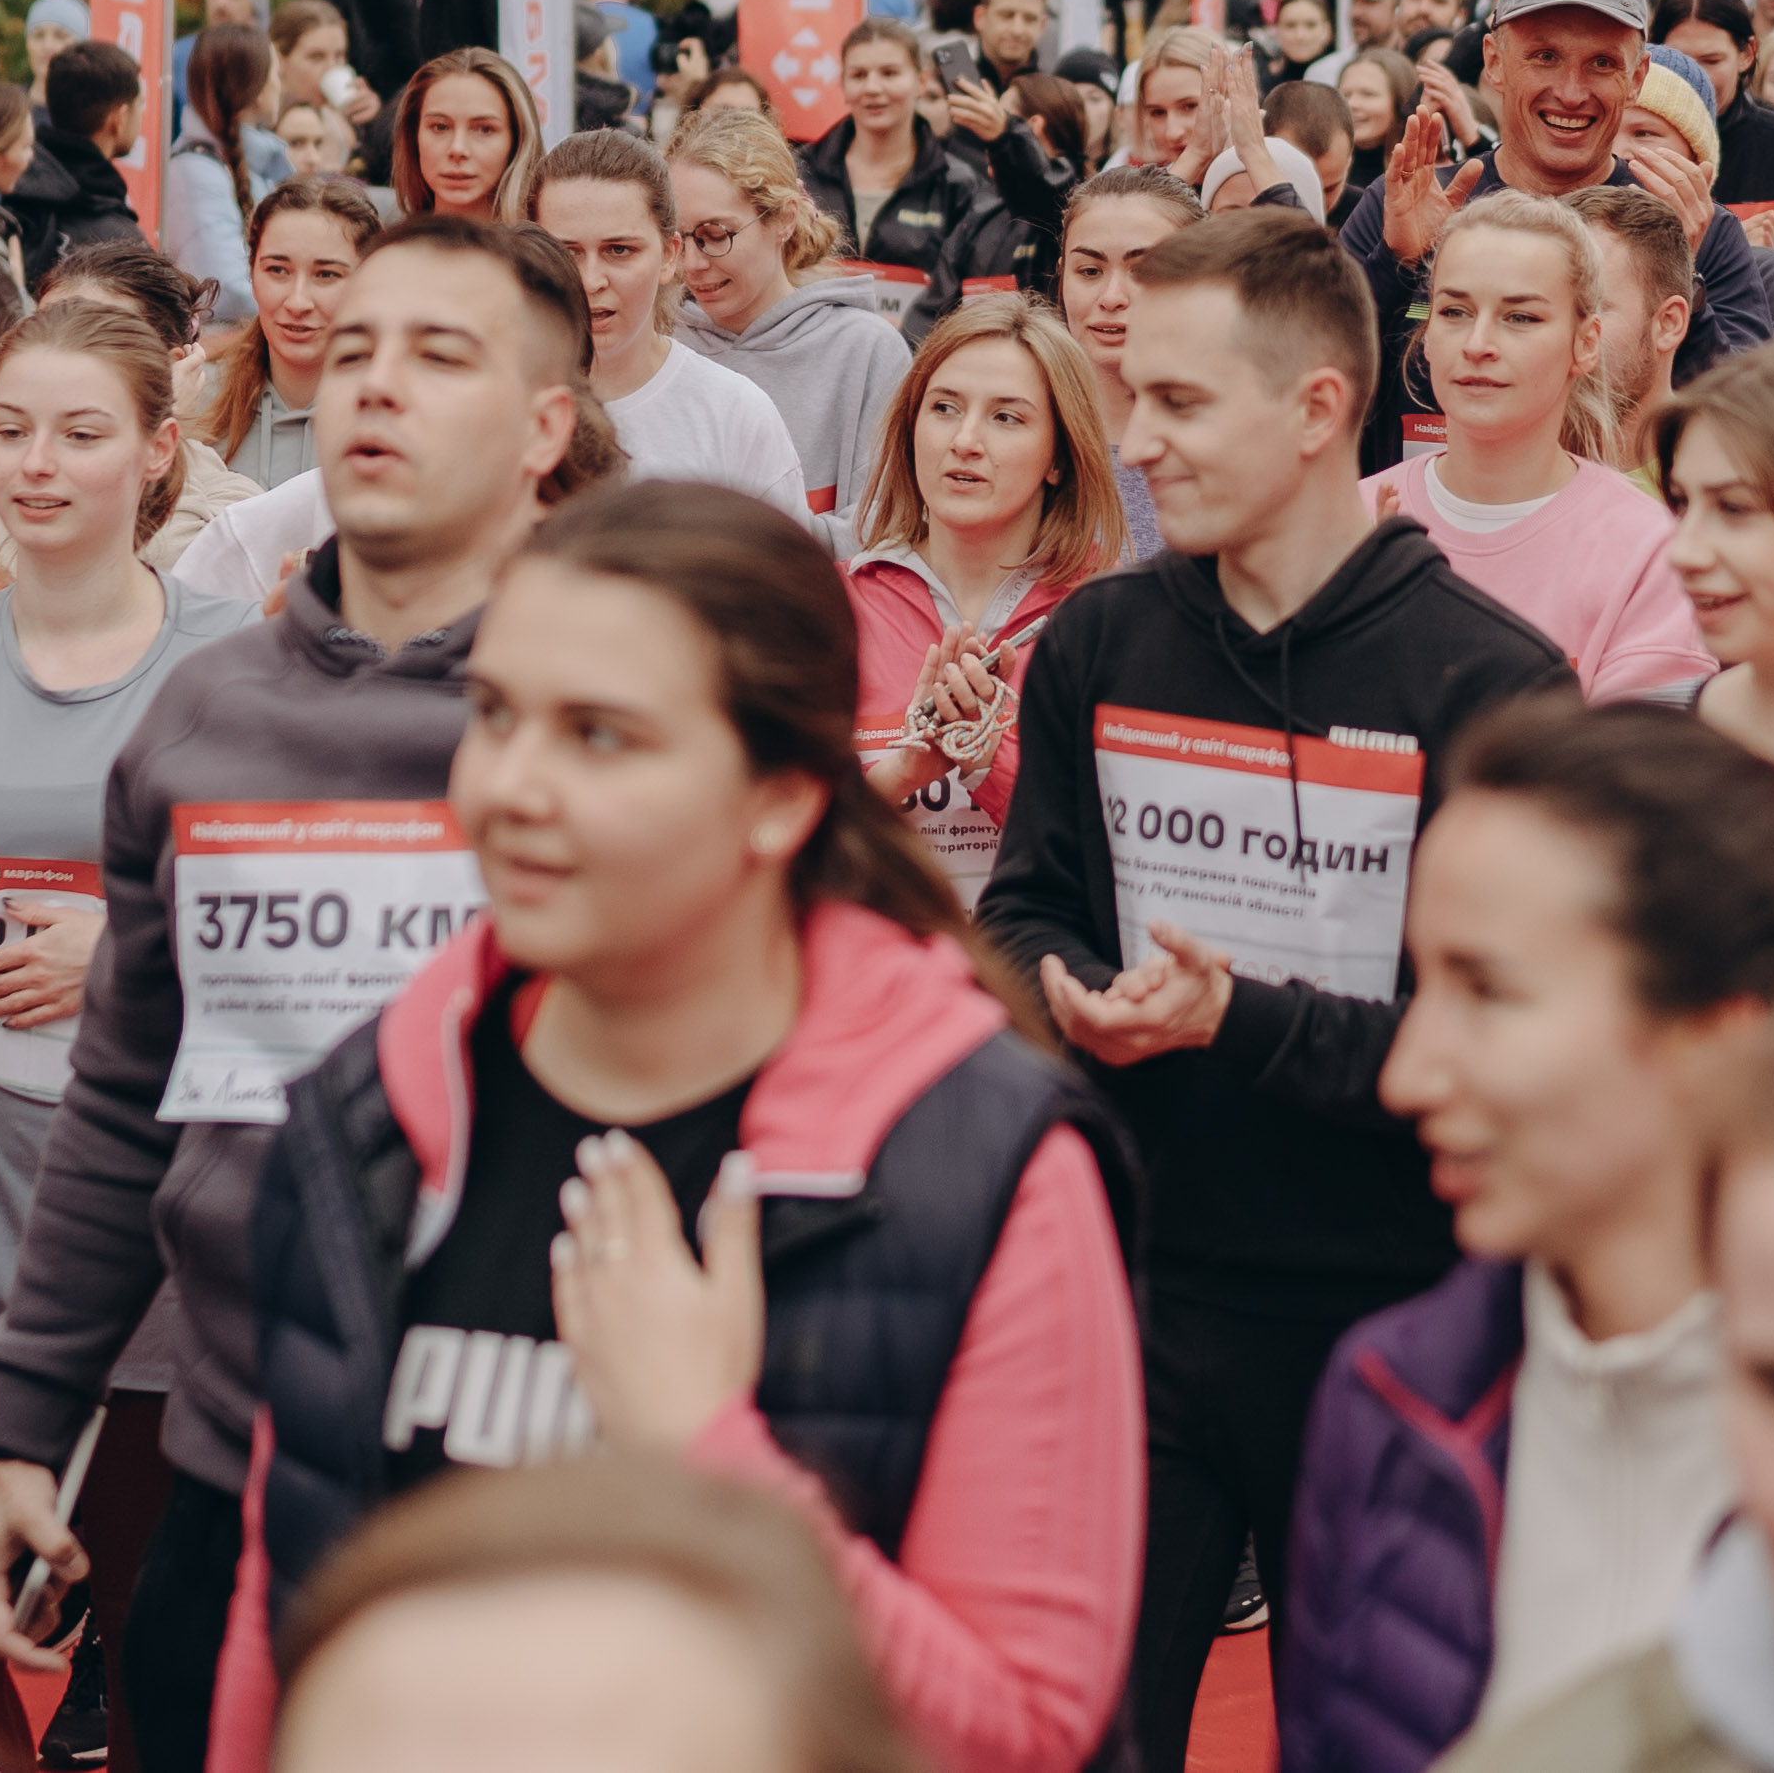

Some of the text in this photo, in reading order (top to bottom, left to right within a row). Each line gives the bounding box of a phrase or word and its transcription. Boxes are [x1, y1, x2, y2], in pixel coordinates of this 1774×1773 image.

[949, 825, 1000, 839] фронту
[1138, 803, 1225, 850] 000
[1240, 828, 1390, 875] годин
[2, 867, 74, 883] марафон
[197, 892, 350, 950] 3750
